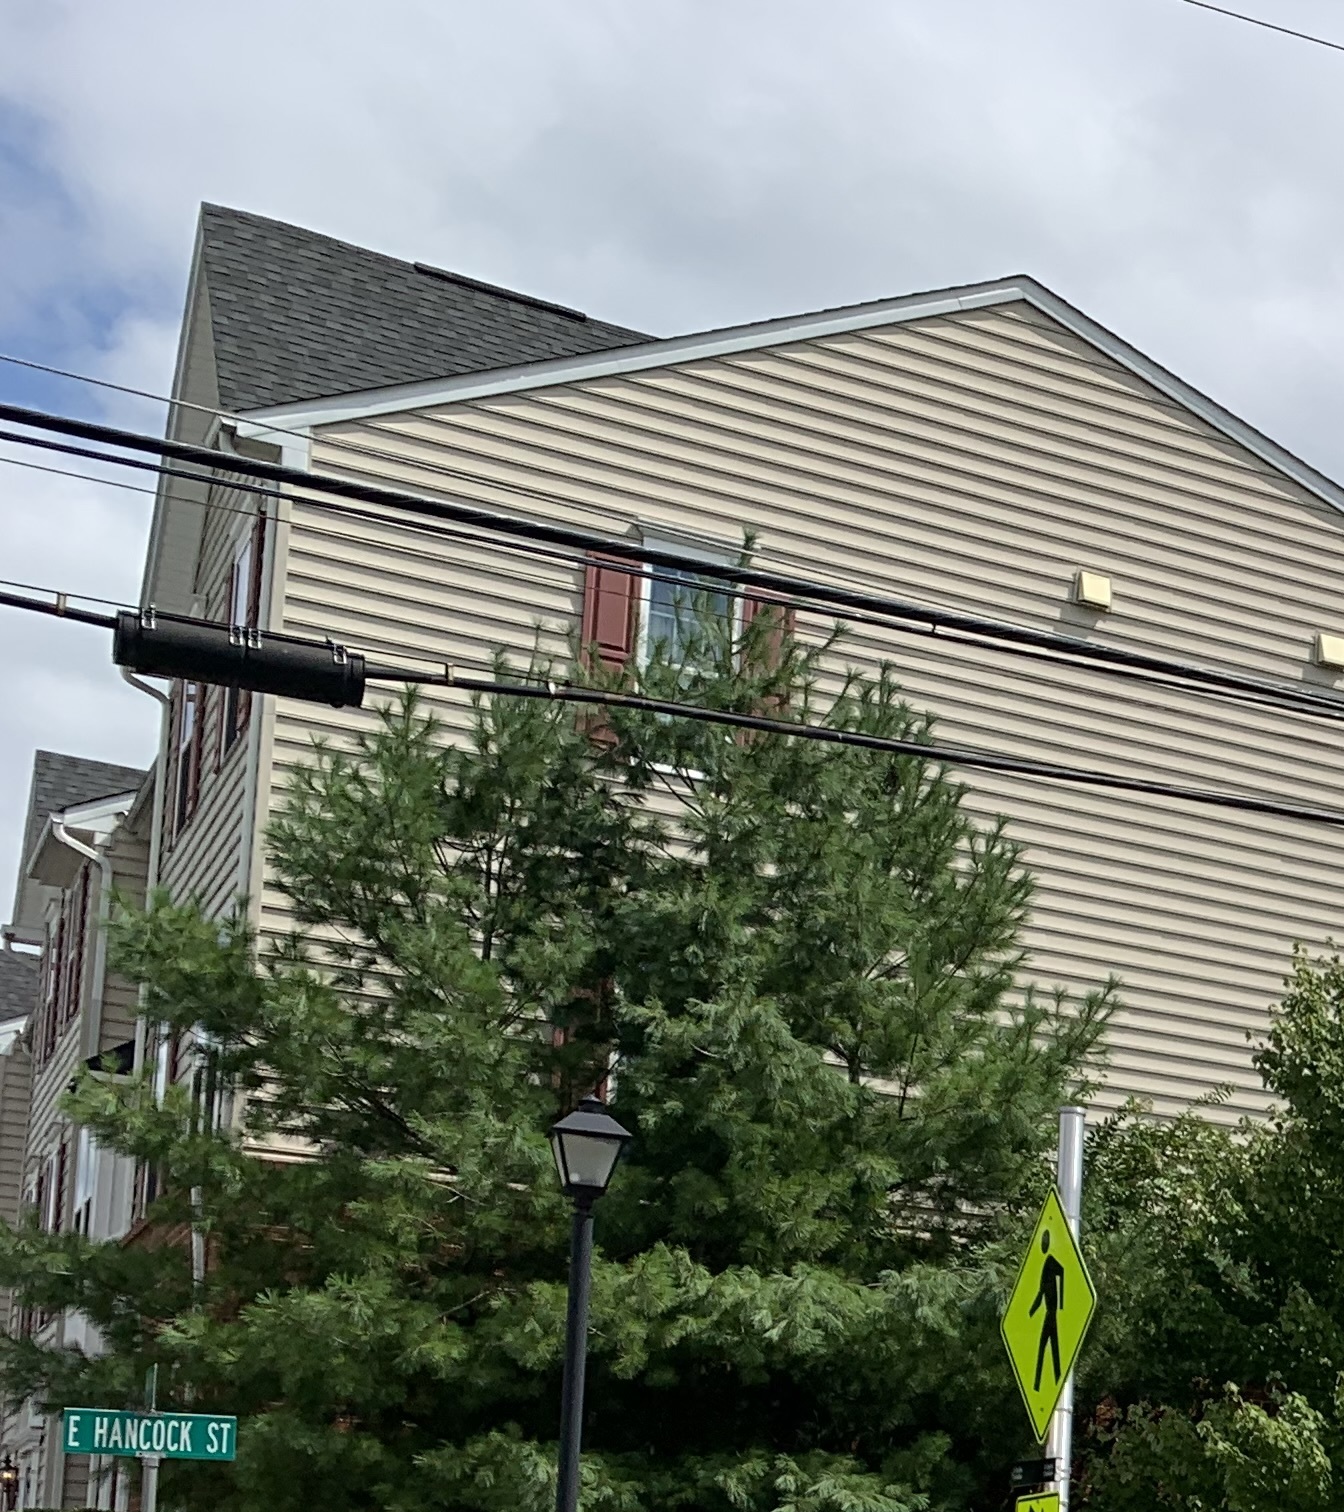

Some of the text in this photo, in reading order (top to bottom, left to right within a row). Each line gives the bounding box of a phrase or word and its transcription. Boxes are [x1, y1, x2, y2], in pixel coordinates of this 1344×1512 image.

[67, 1415, 231, 1454] E HANCOCK ST
